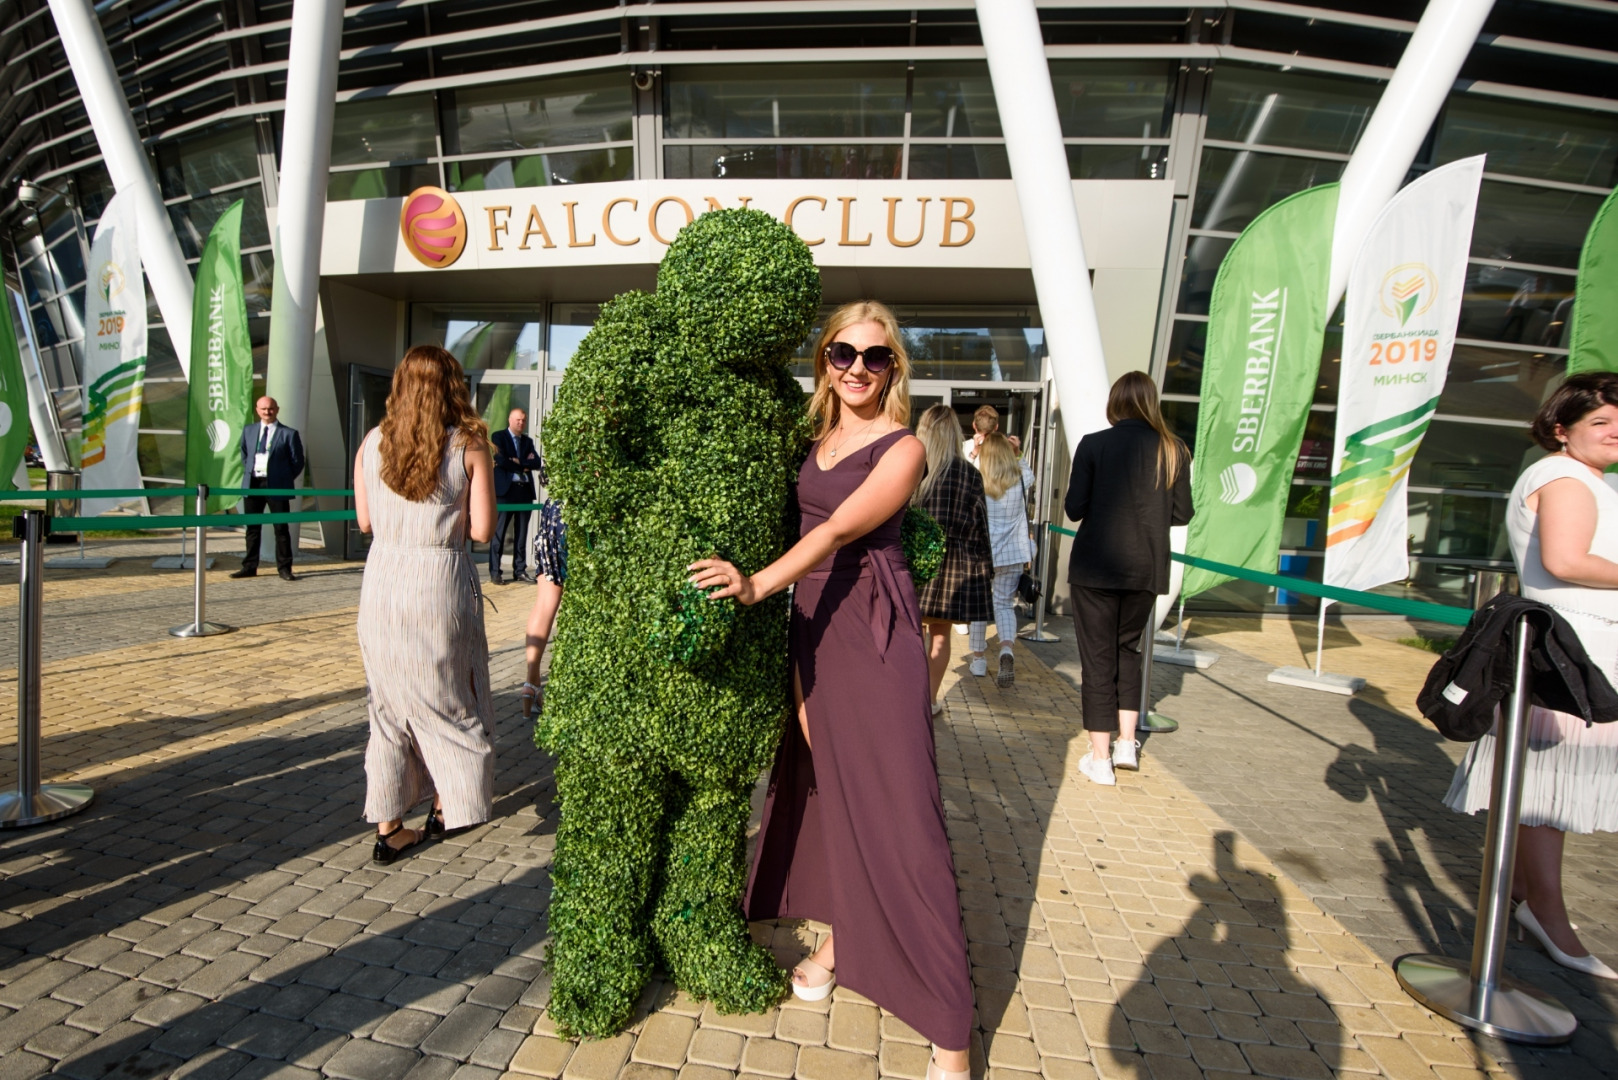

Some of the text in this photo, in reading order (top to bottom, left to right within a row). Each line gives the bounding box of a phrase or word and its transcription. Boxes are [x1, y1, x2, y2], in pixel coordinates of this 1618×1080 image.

[483, 195, 976, 251] FALCO CLUB
[97, 316, 125, 336] 2019
[208, 284, 225, 412] SBERBANK
[1369, 338, 1438, 366] 2019
[1232, 287, 1280, 453] SBERBANK
[1374, 372, 1428, 386] МИНСК
